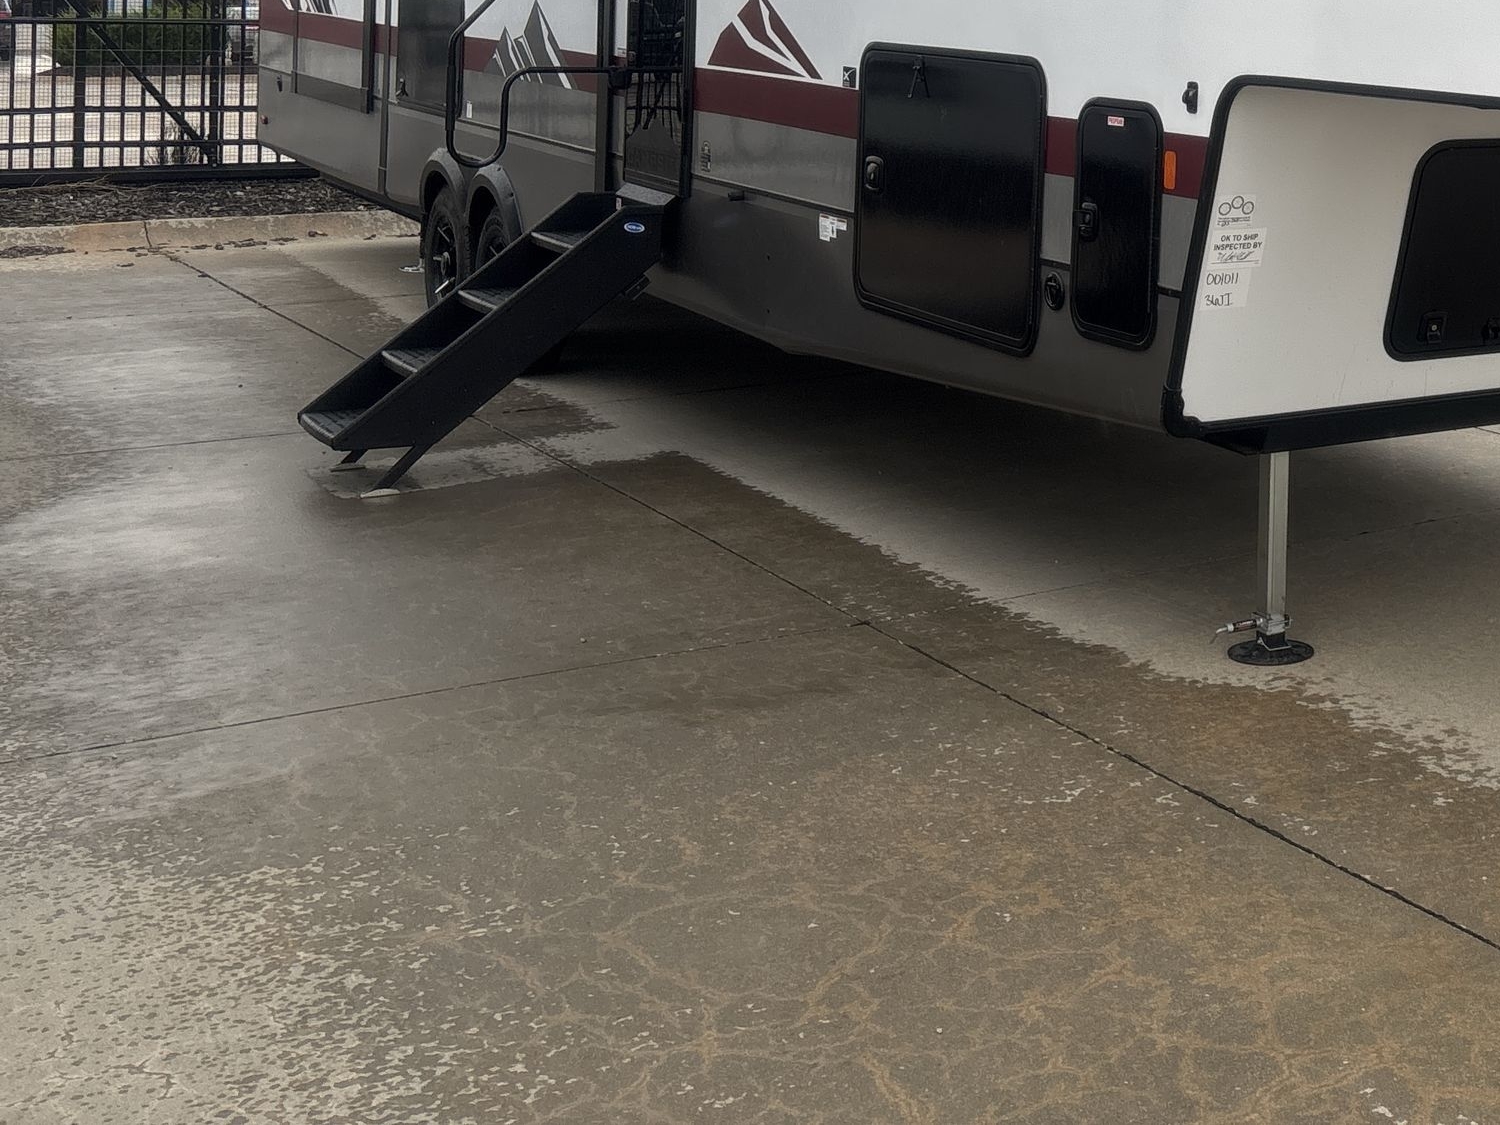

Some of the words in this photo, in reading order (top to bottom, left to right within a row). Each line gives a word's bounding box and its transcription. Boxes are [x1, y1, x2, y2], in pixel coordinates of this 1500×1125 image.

[1220, 234, 1231, 243] OK
[1232, 234, 1242, 242] TO
[1243, 233, 1259, 241] SHIP
[1213, 242, 1252, 251] INSPECTED
[1252, 241, 1263, 249] BY
